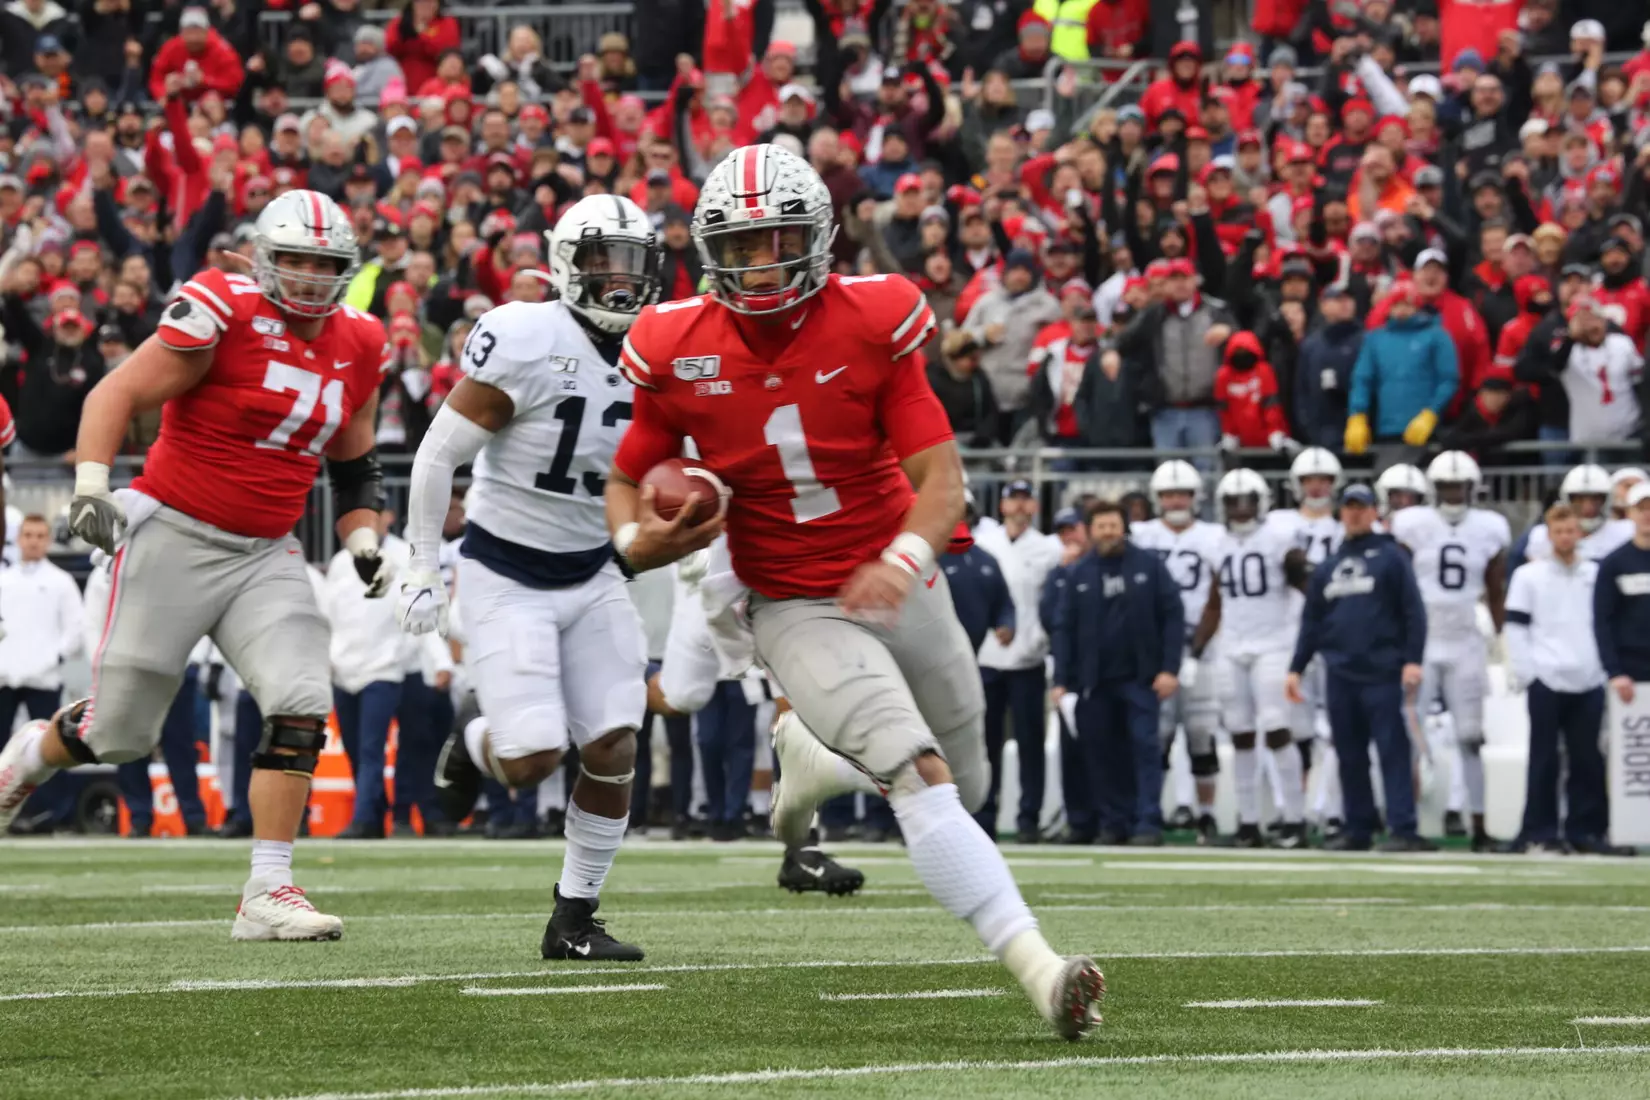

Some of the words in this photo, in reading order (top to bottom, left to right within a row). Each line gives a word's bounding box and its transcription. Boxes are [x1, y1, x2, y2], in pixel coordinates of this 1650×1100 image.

[465, 323, 497, 368] 13
[254, 359, 345, 456] 71
[763, 403, 843, 524] 1
[1218, 552, 1268, 598] 40
[1438, 543, 1467, 590] 6
